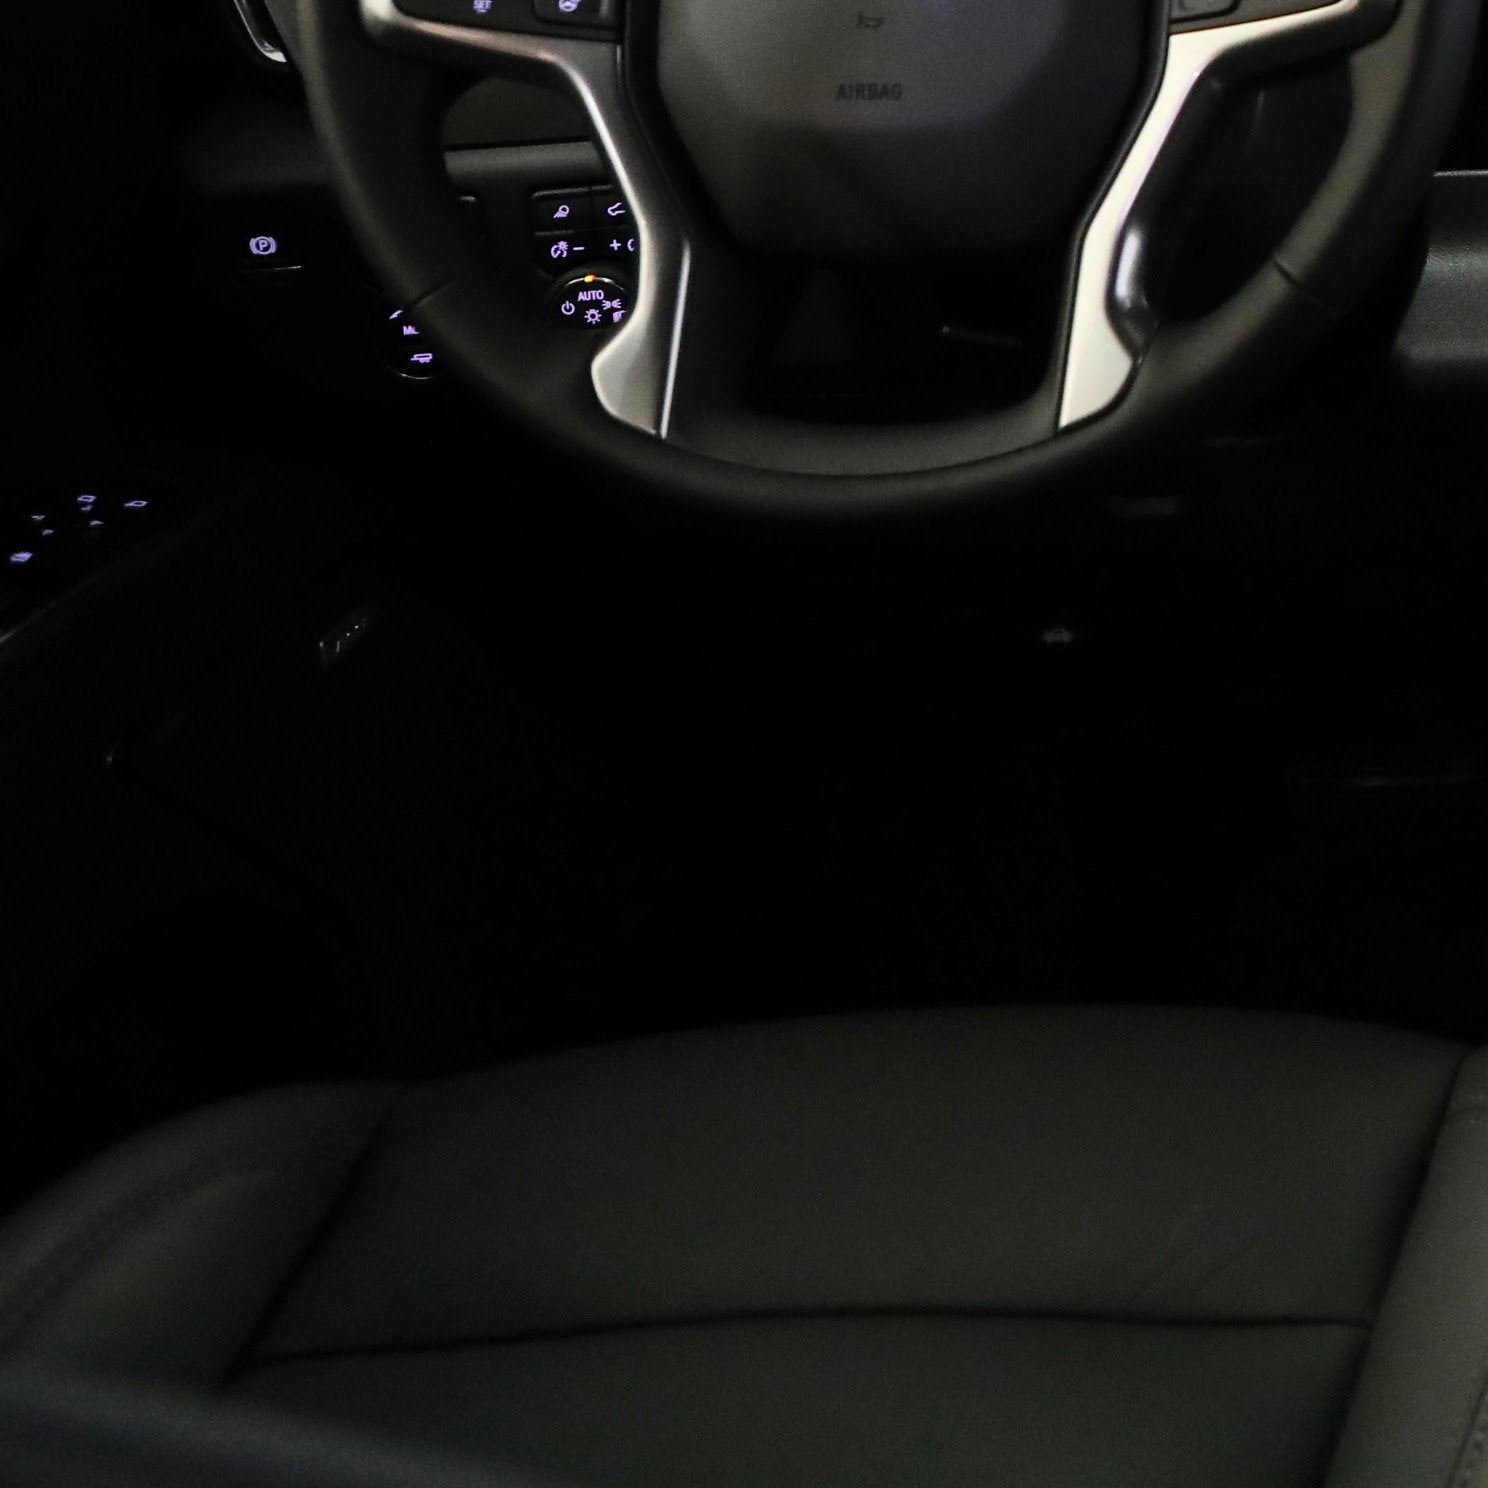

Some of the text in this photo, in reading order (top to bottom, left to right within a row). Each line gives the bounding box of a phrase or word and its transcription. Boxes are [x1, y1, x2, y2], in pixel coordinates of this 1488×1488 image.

[473, 0, 492, 9] SET
[836, 83, 902, 101] AIRBAG
[577, 290, 605, 302] AUTO
